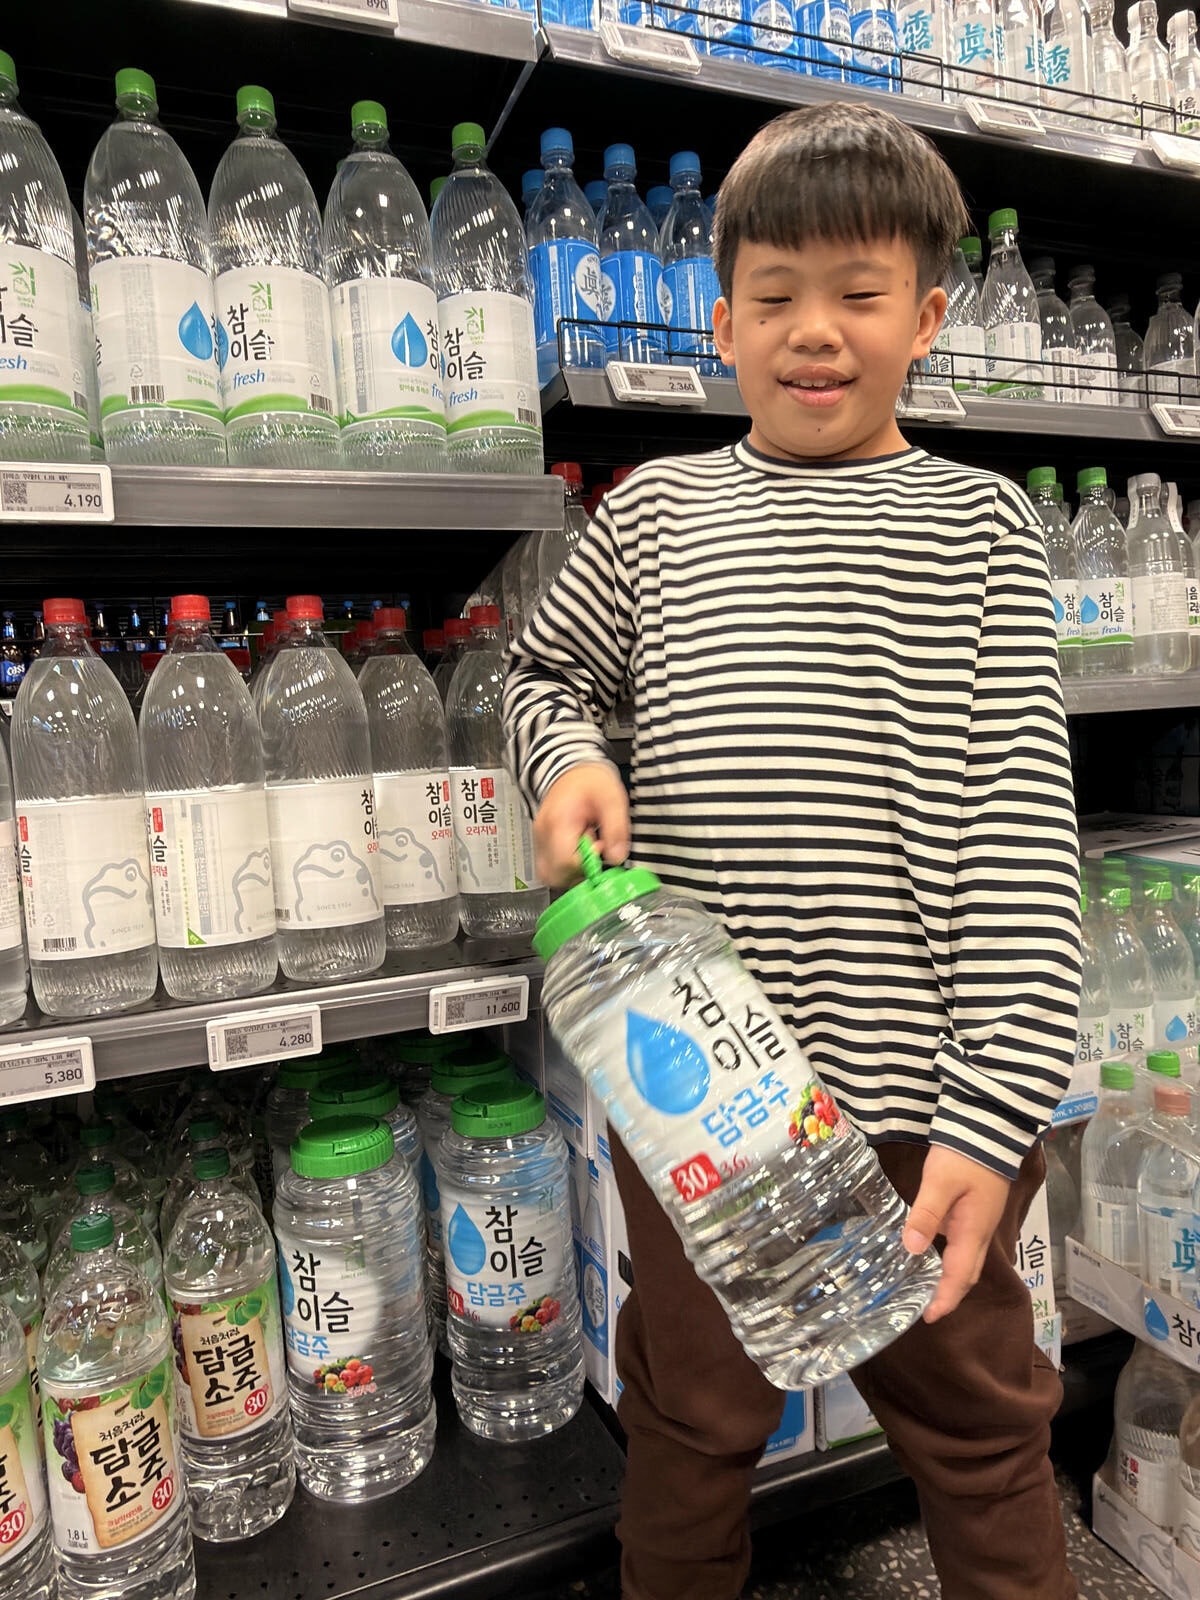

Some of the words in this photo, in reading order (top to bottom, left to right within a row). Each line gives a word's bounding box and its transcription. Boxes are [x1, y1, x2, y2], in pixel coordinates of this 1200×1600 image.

[226, 303, 249, 334] 참
[230, 329, 275, 362] 이슬
[444, 327, 465, 357] 참
[232, 368, 265, 389] fresh
[446, 351, 487, 381] 이슬
[449, 387, 478, 406] fresh
[64, 494, 102, 508] 4,190
[1064, 592, 1076, 610] 참
[1098, 591, 1115, 608] 참
[1100, 605, 1126, 623] 이슬
[1101, 625, 1122, 636] fresh
[361, 788, 374, 815] 참
[426, 781, 442, 806] 참
[461, 778, 479, 802] 참
[463, 800, 498, 824] 이슬
[672, 967, 726, 1028] 참
[280, 1032, 313, 1048] 4,280
[712, 1004, 787, 1071] 이슬
[1077, 1032, 1094, 1049] 참
[1116, 1022, 1133, 1039] 참
[45, 1068, 83, 1085] 5,380
[700, 1070, 790, 1149] 담금주
[485, 1204, 519, 1244] 참
[292, 1249, 321, 1292] 참
[490, 1236, 547, 1278] 이슬
[466, 1281, 527, 1308] 담금주
[297, 1291, 354, 1334] 이슬
[200, 1327, 240, 1346] 처음처럼
[193, 1334, 256, 1376] 담금
[204, 1362, 262, 1408] 소주
[247, 1390, 267, 1415] 30
[99, 1410, 146, 1442] 처음처럼
[89, 1417, 161, 1476] 담금
[105, 1448, 168, 1513] 소주
[154, 1481, 174, 1509] 30
[0, 1510, 24, 1543] 30
[67, 1529, 80, 1541] 1.8
[81, 1530, 88, 1541] L
